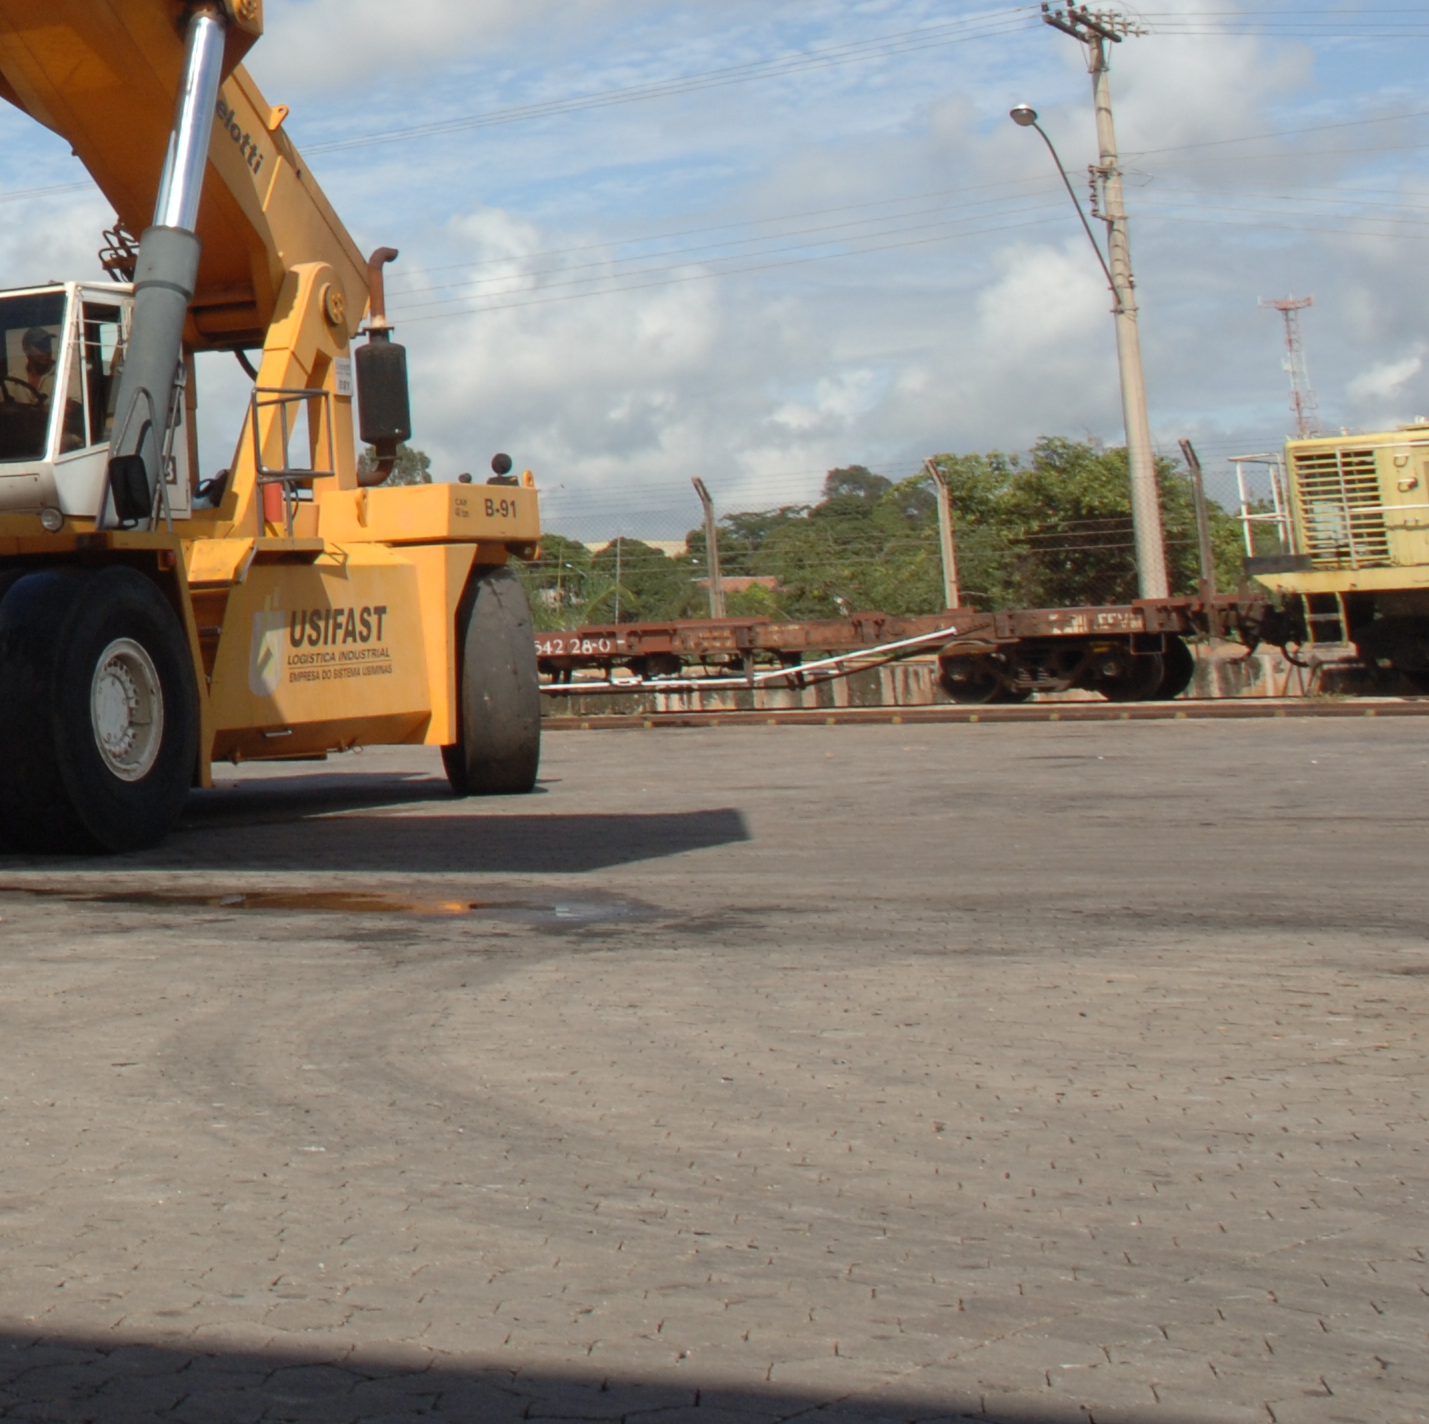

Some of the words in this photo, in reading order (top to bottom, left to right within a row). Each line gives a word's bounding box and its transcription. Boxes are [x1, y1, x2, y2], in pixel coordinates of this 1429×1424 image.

[216, 100, 263, 174] elotti
[485, 498, 516, 518] B-91
[290, 605, 387, 648] USIFAST
[338, 648, 391, 662] INDUSTRIAL
[289, 671, 320, 683] EMPRESA
